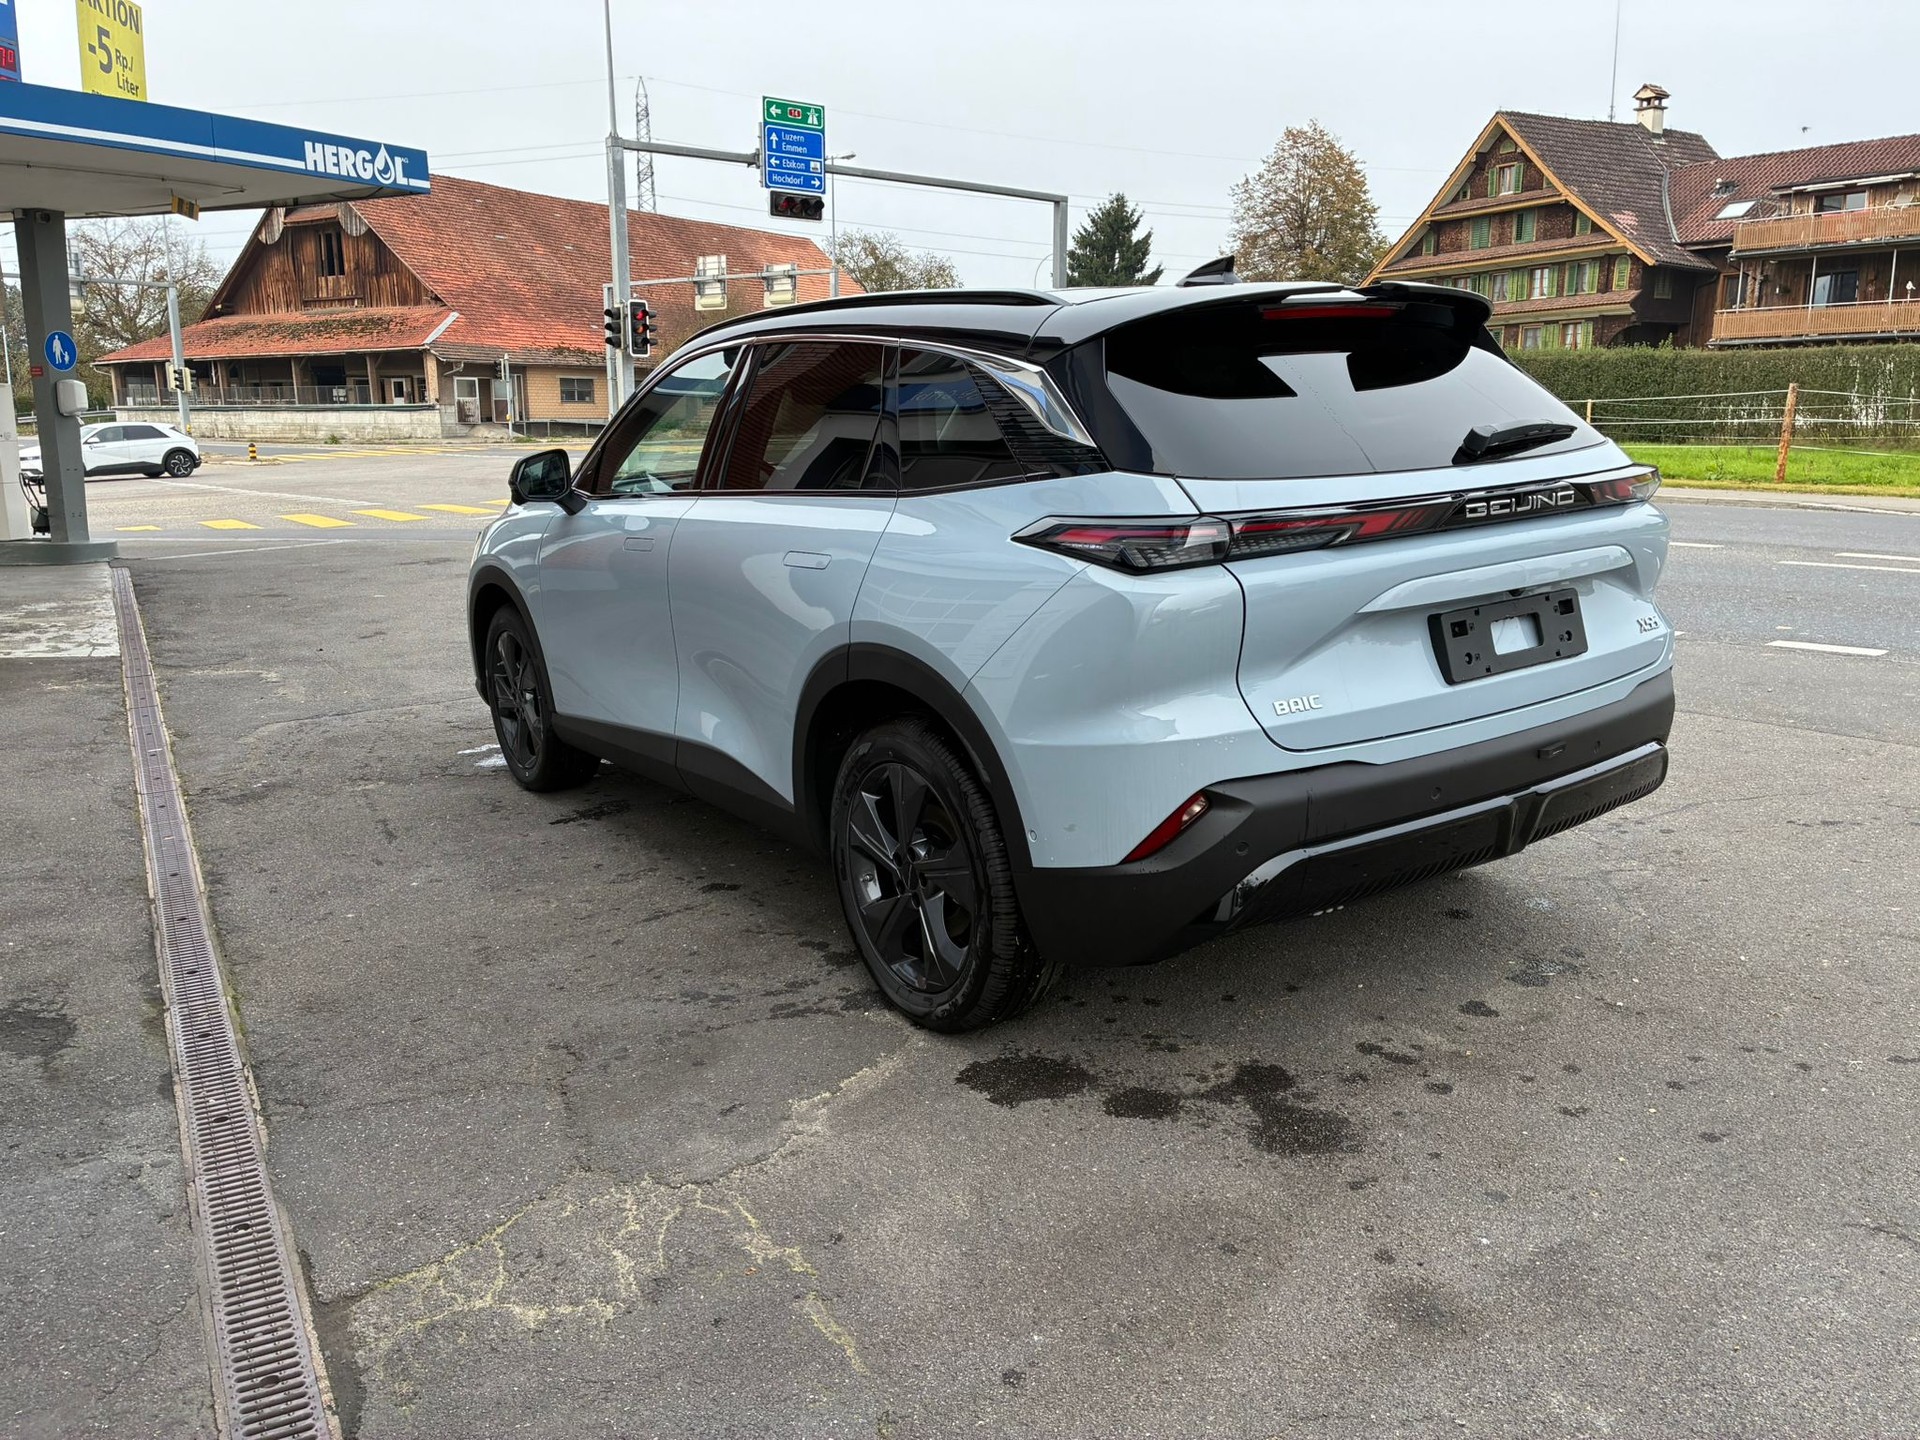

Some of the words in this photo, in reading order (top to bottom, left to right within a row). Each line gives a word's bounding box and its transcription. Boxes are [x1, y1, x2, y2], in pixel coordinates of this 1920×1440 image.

[81, 0, 139, 34] KTION
[88, 25, 112, 74] -5
[117, 72, 139, 97] Liter
[782, 132, 804, 142] Luzern
[782, 143, 807, 153] Emmen
[782, 159, 805, 170] Ebikon
[772, 174, 803, 185] Hochdorf
[1466, 490, 1575, 518] BEIJING
[1272, 695, 1322, 716] BAIC
